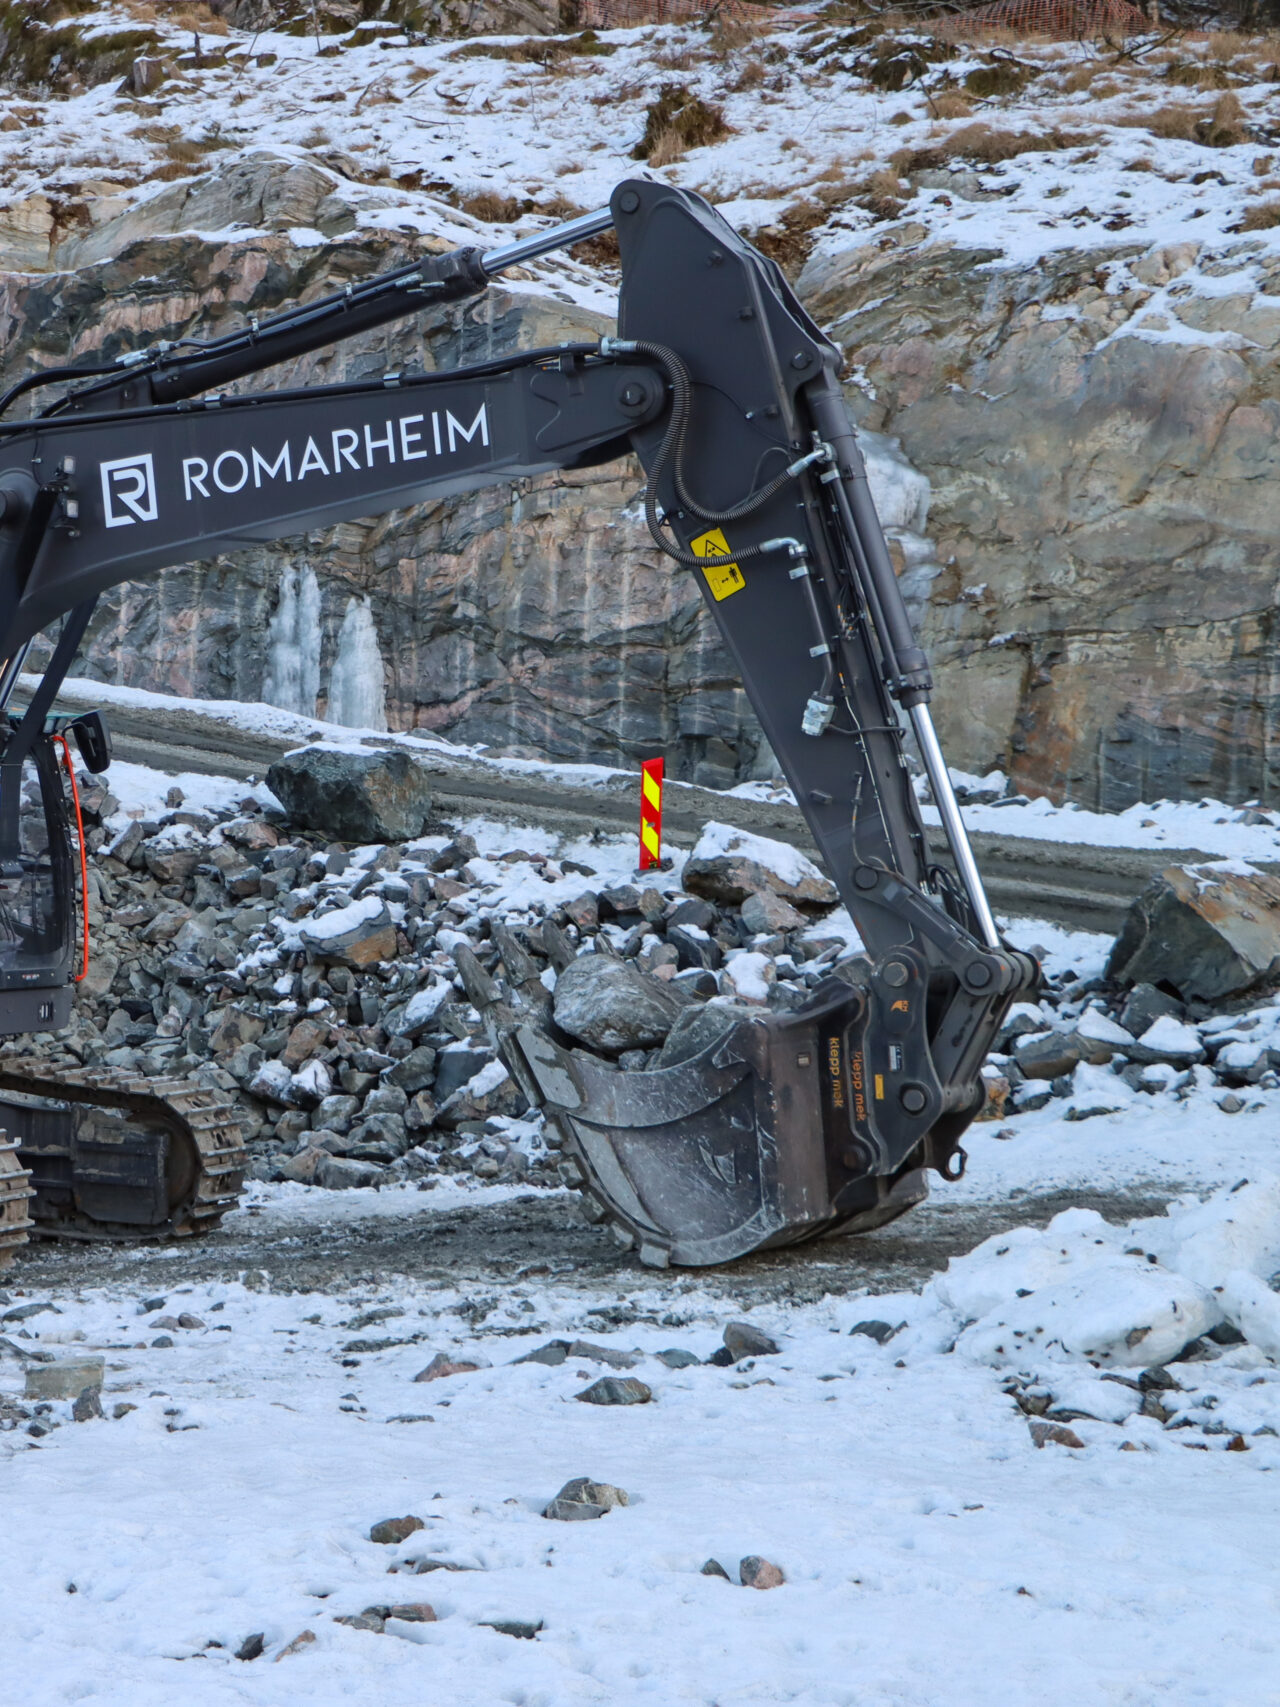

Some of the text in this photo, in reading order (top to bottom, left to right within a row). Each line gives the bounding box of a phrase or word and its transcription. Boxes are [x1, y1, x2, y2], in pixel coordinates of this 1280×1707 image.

[182, 402, 489, 501] ROMARHEIM
[829, 1037, 840, 1076] klepp
[855, 1093, 867, 1121] mek
